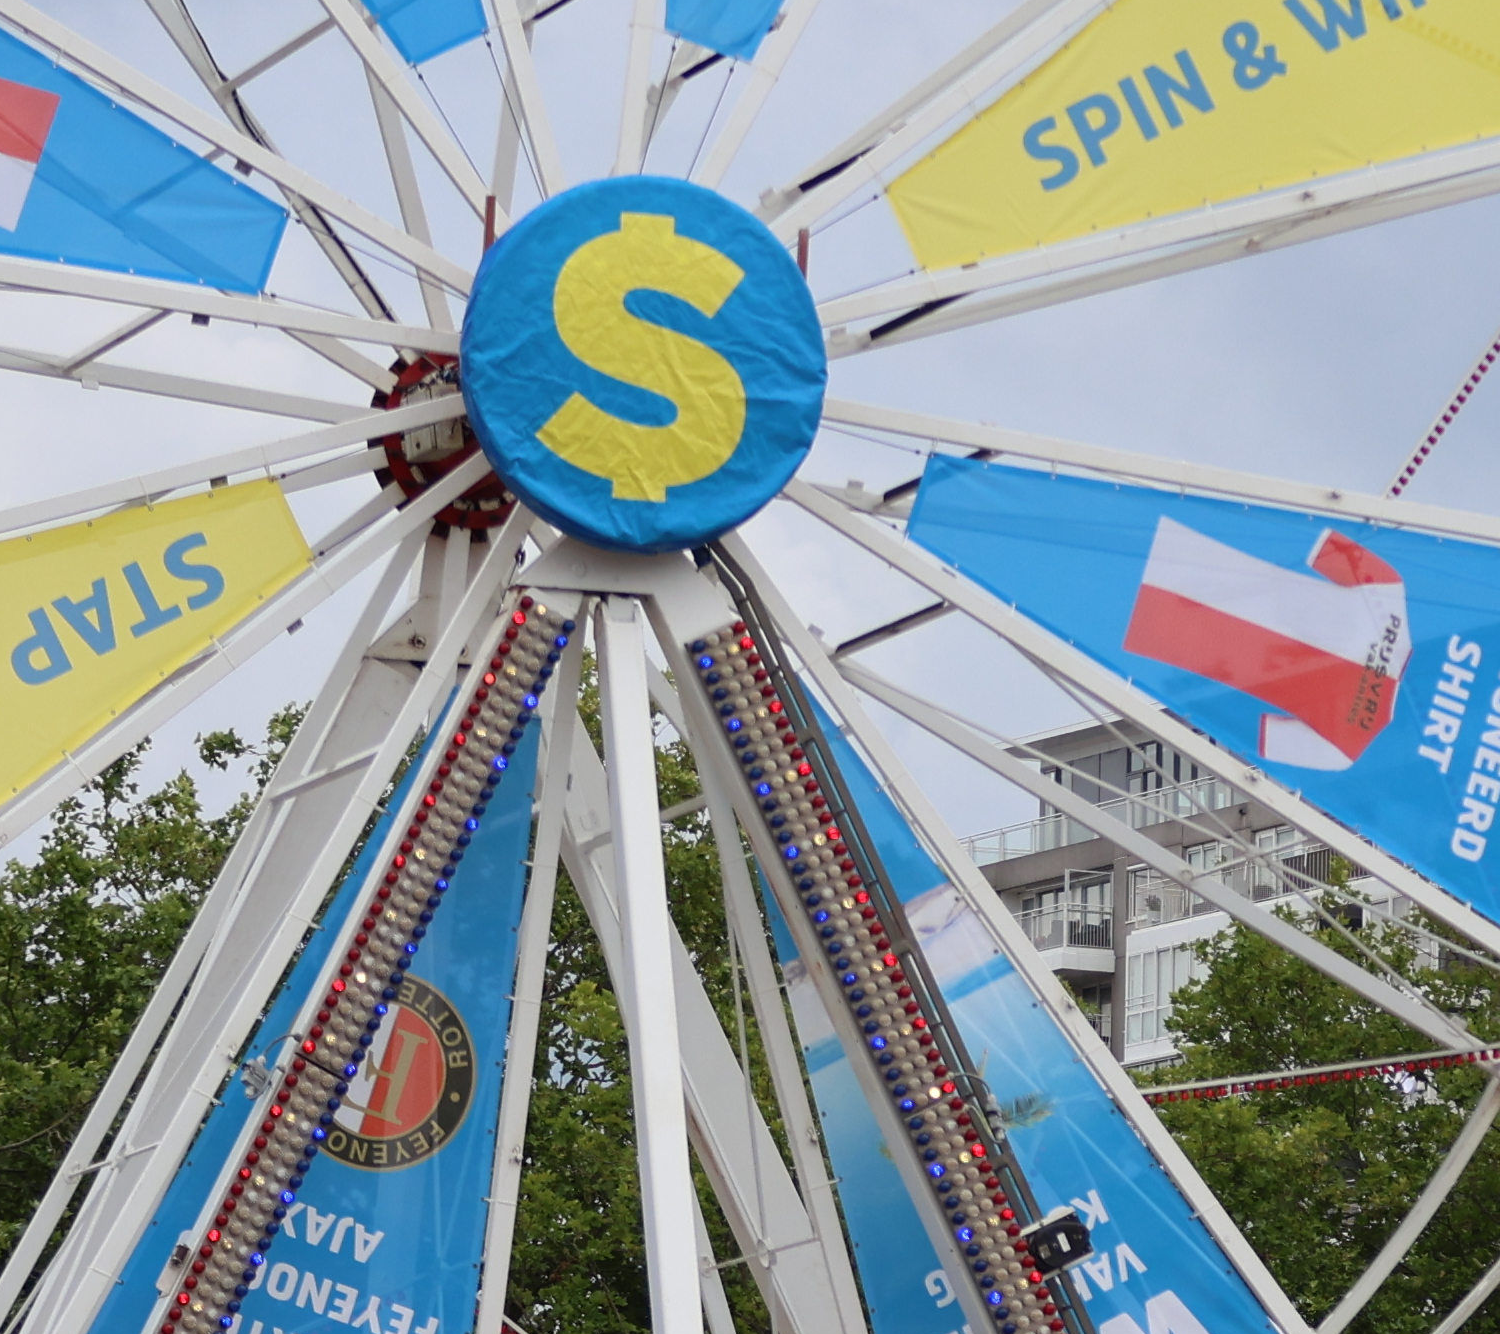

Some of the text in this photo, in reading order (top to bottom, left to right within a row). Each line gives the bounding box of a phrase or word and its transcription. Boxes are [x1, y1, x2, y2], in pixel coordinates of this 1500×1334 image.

[1022, 49, 1217, 192] SPIN
[1222, 20, 1288, 92] &
[9, 532, 226, 686] STAP
[1416, 634, 1481, 775] SHIRT
[398, 980, 469, 1070] ROTTE
[328, 1119, 446, 1165] FEYENO
[281, 1202, 386, 1264] AJAX
